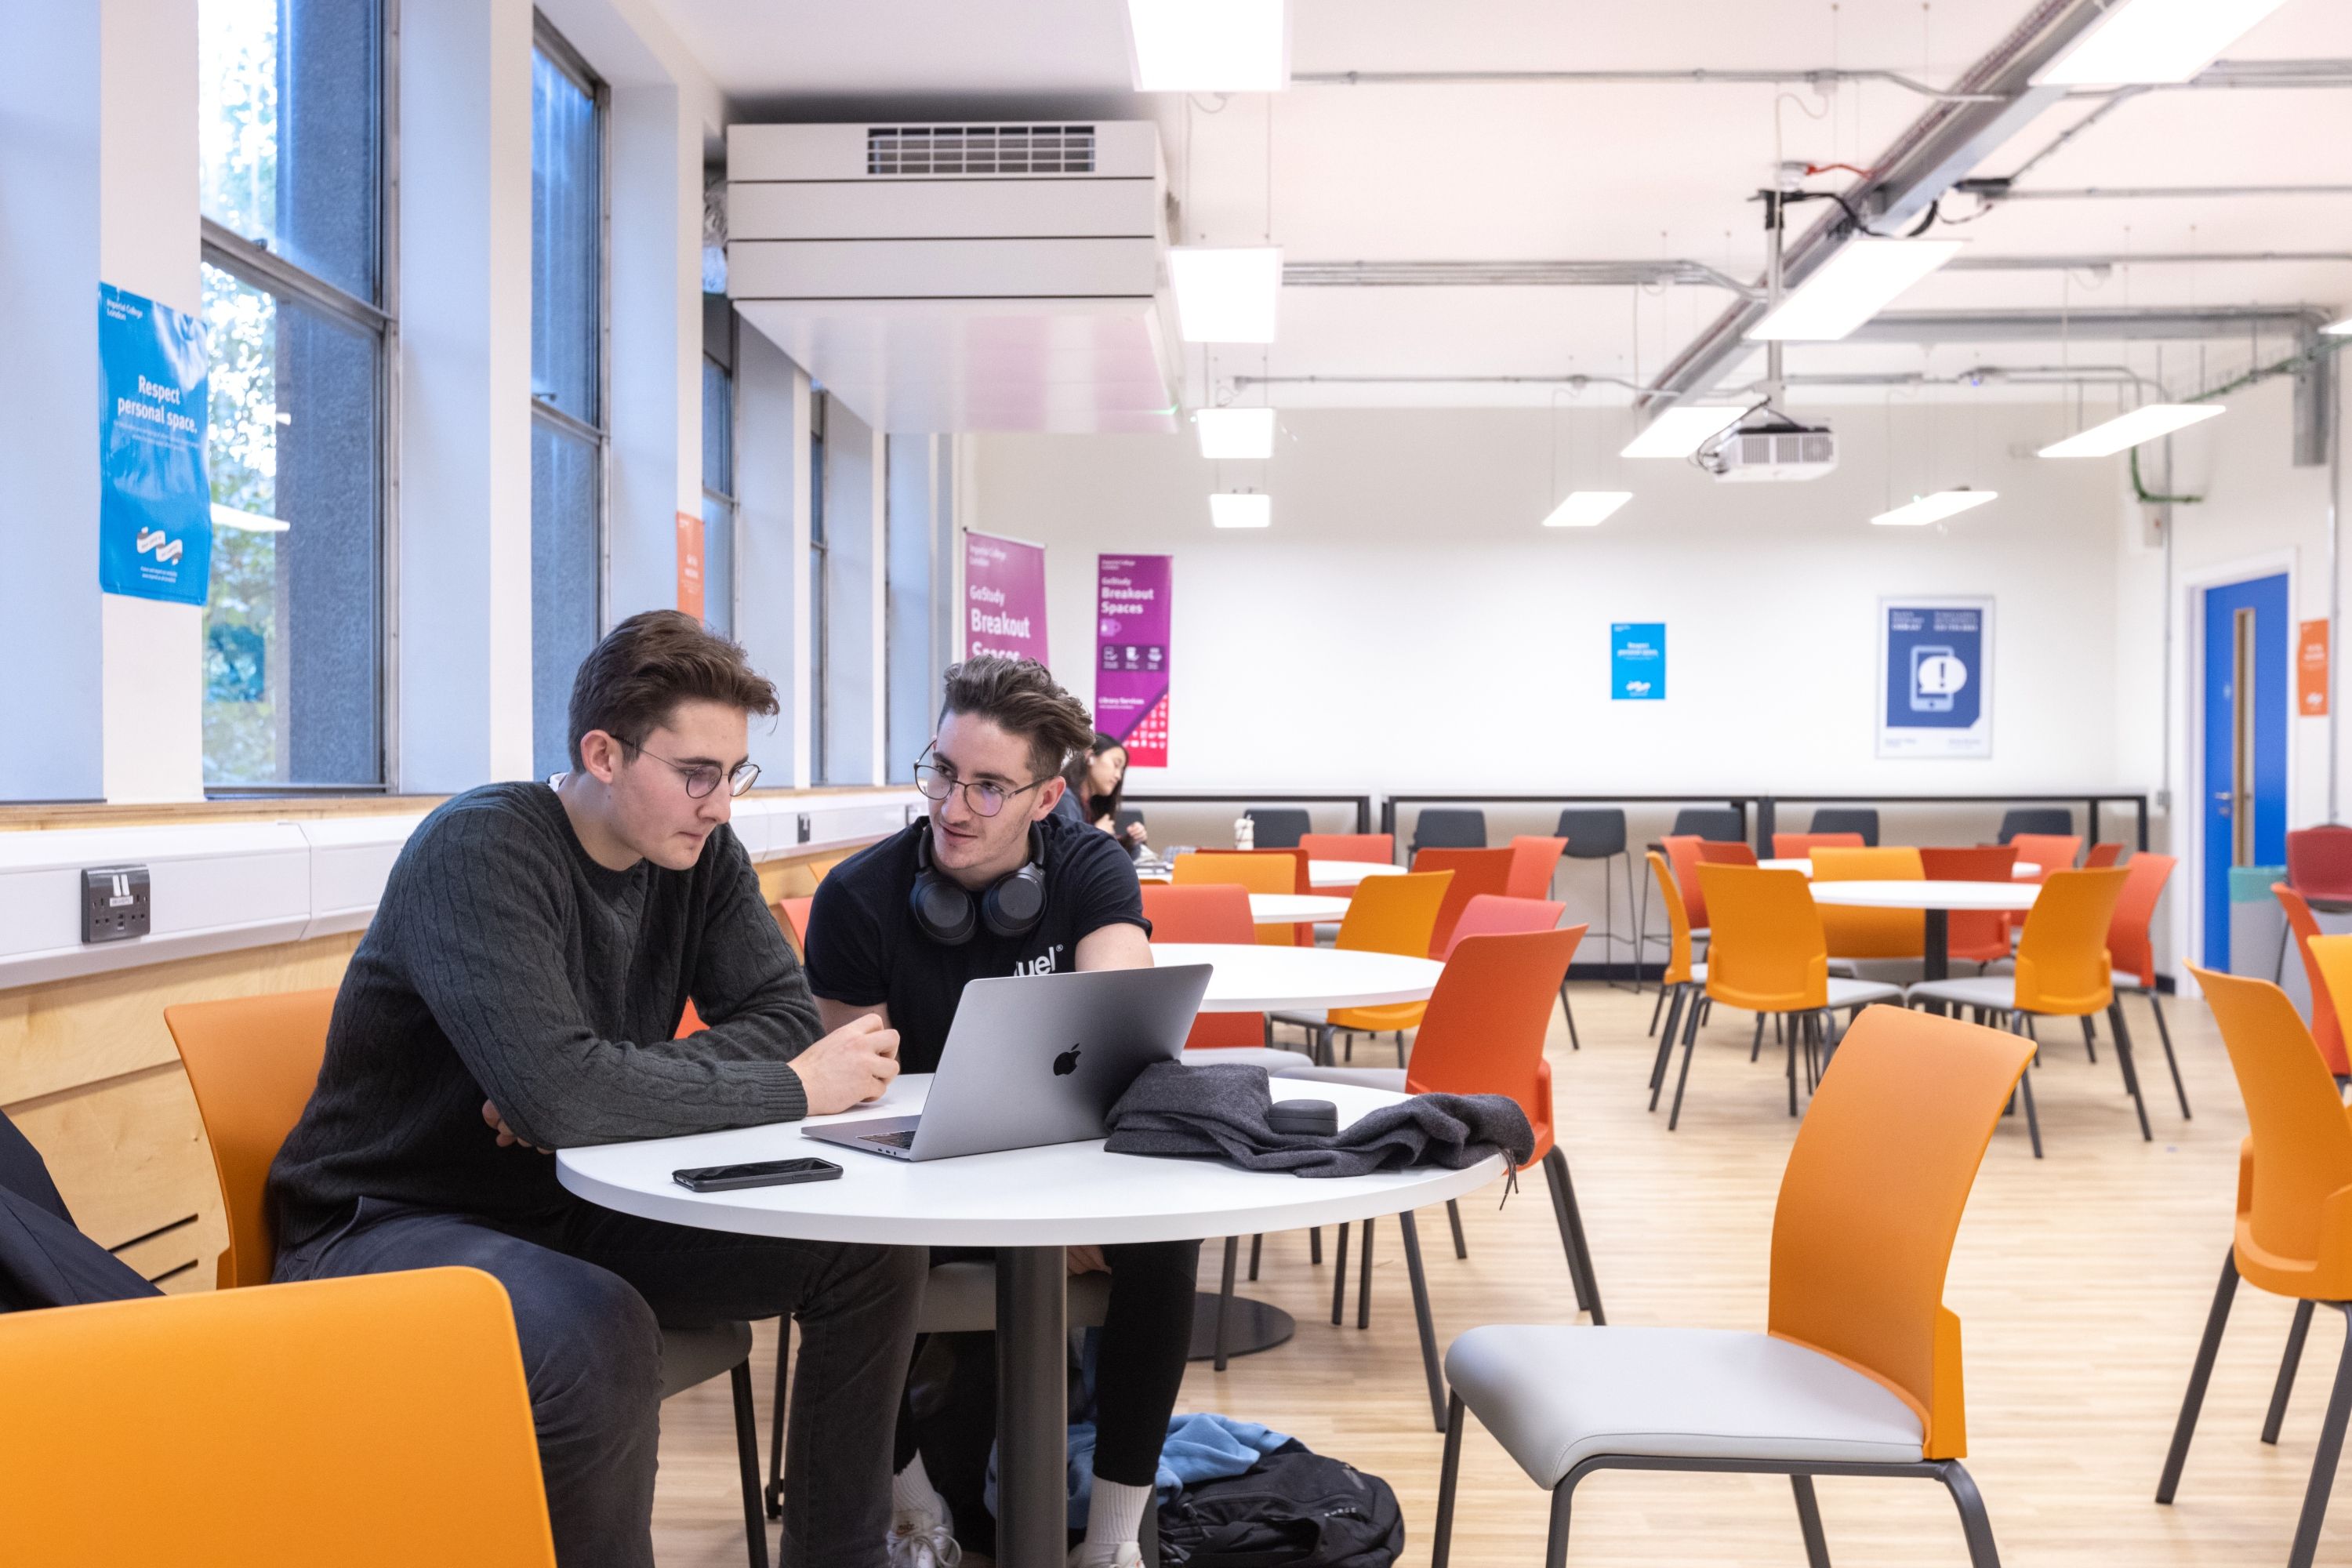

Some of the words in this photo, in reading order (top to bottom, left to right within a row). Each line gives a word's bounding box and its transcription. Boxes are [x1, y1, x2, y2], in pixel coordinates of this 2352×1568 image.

[138, 374, 180, 405] Respect
[118, 397, 165, 424] personal
[167, 412, 198, 434] space.
[1101, 576, 1131, 586] GoStudy
[969, 584, 1005, 608] GoStudy
[1101, 586, 1154, 601] Breakout
[1101, 601, 1143, 616] Spaces
[971, 608, 1031, 639] Breakout
